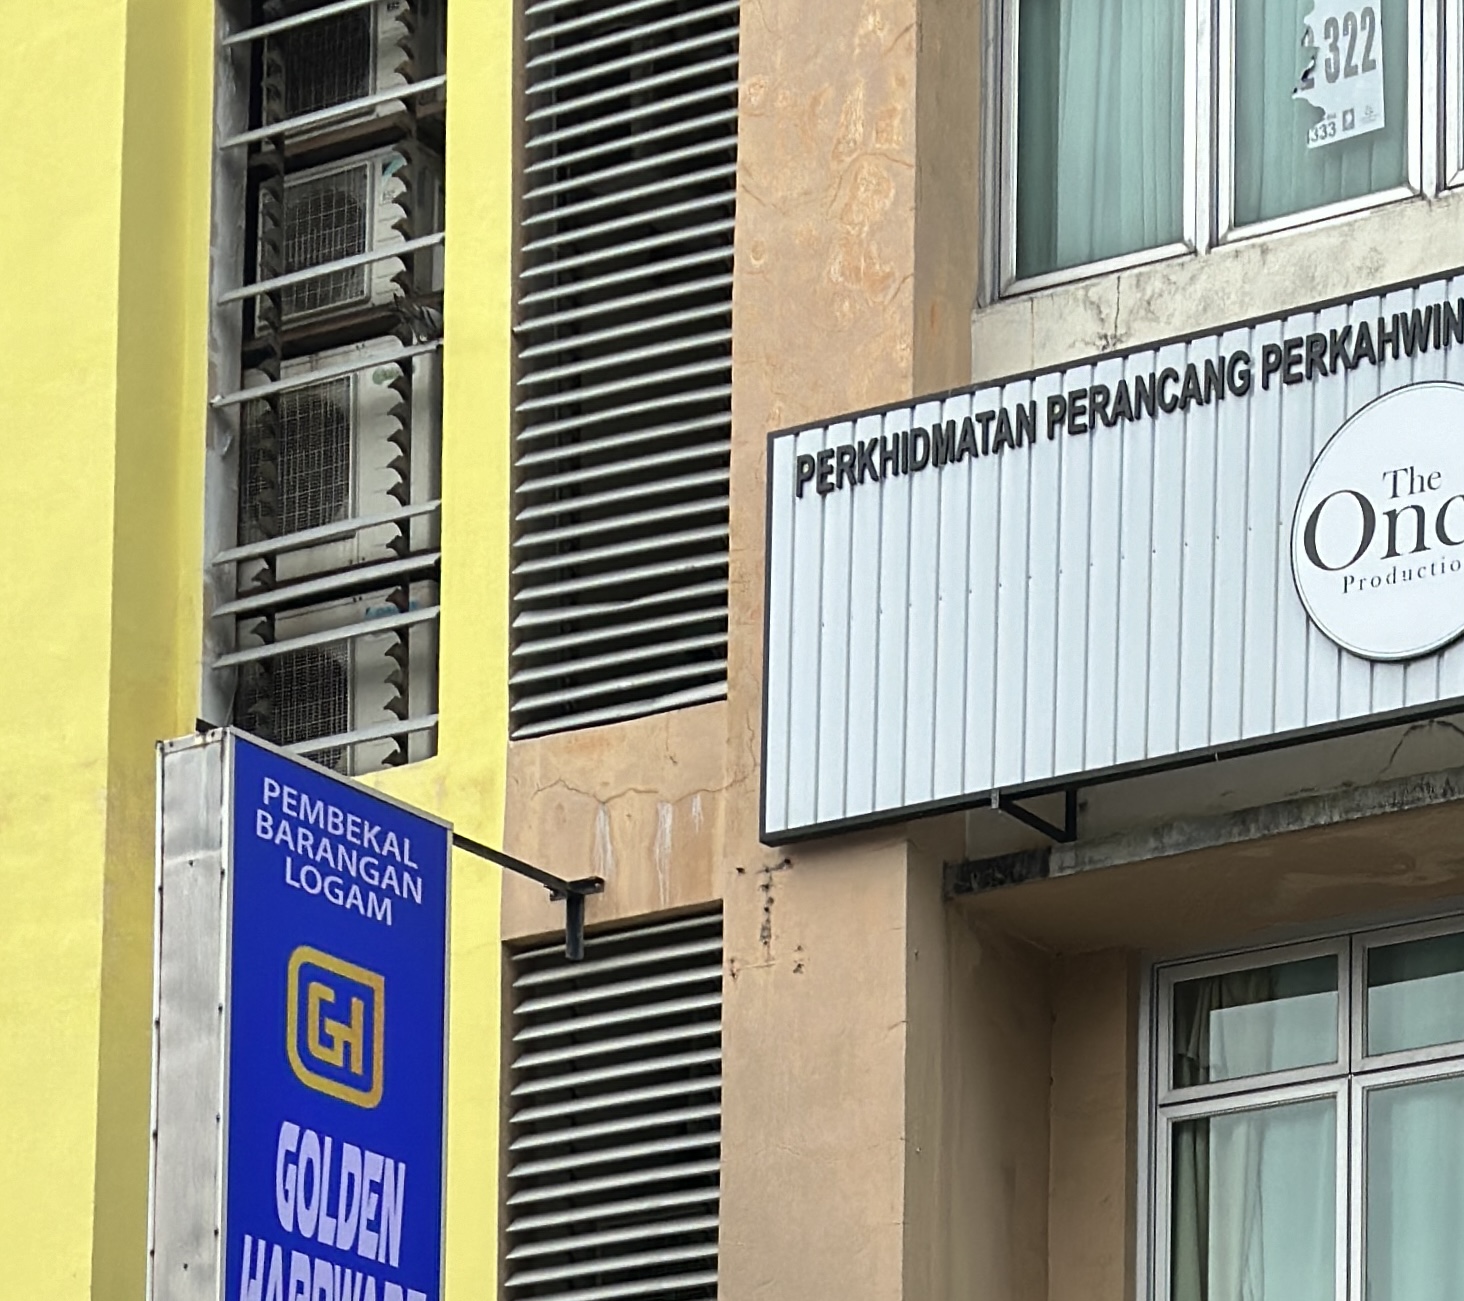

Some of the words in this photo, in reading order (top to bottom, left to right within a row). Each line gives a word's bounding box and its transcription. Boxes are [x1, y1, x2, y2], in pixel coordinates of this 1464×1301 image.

[796, 400, 1037, 498] PERKHIDMATAN
[1046, 350, 1253, 441] PERANCANG
[1382, 466, 1443, 500] The
[256, 809, 422, 905] BARANGAN
[263, 776, 418, 870] PEMBEKAL
[285, 857, 392, 927] LOGAM
[276, 1121, 406, 1268] GOLDEN
